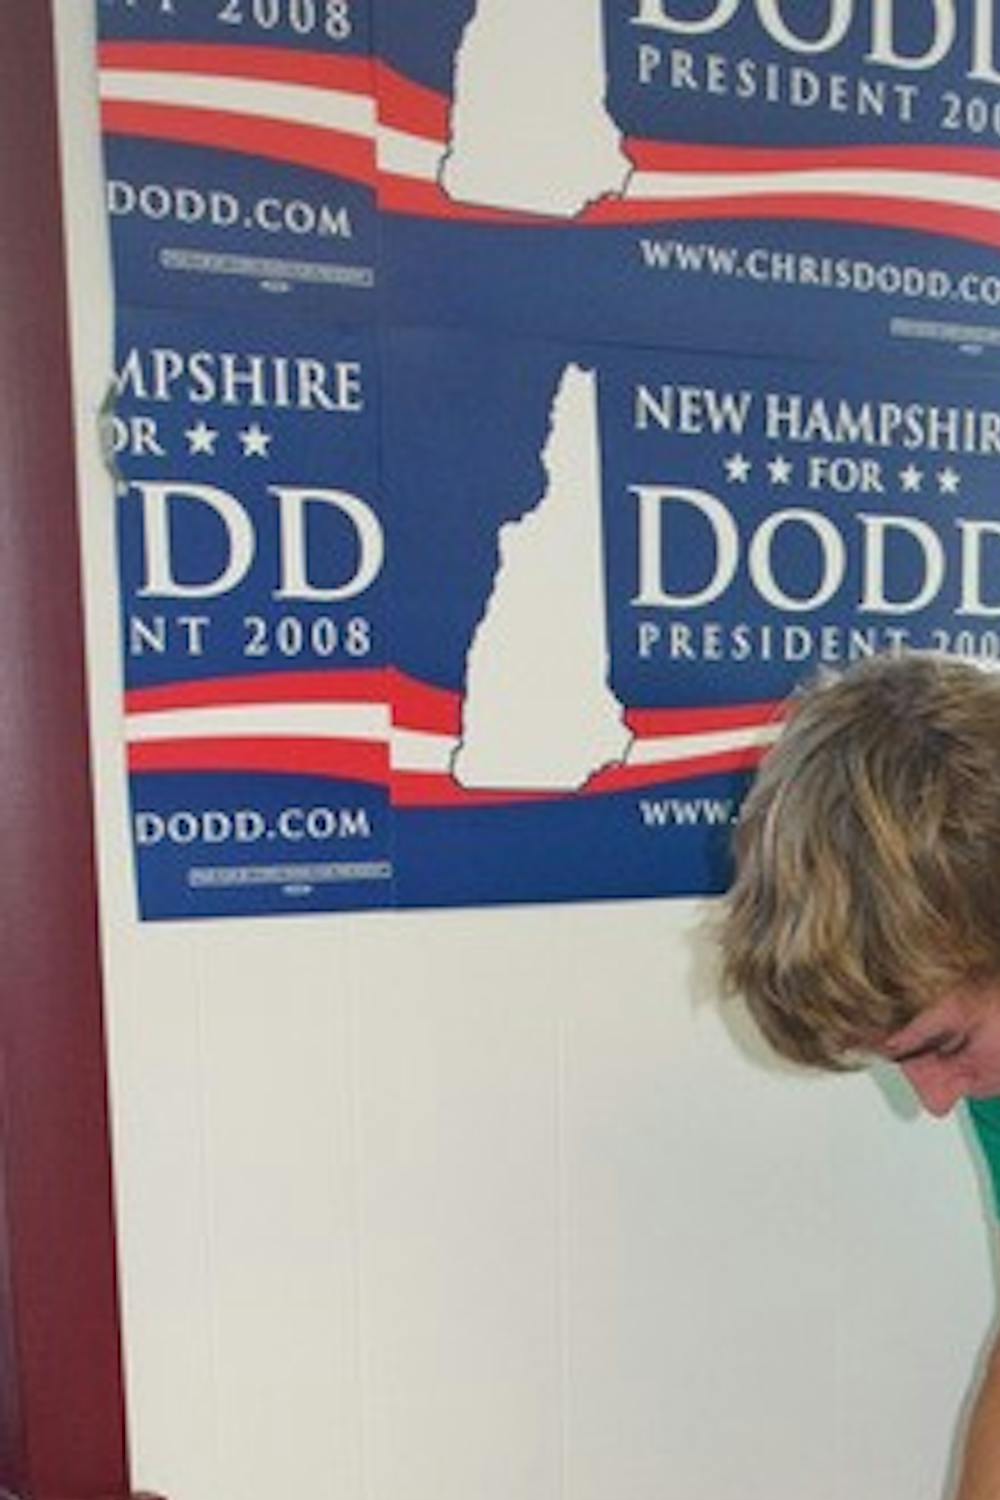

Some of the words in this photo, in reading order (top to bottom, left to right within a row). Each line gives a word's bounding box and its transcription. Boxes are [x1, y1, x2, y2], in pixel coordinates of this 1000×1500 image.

[217, 0, 352, 40] 2008
[638, 45, 919, 121] PRESIDENT
[107, 179, 351, 239] DODD.COM
[633, 383, 752, 435] NEW
[808, 456, 884, 493] FOR
[130, 614, 211, 656] NT
[243, 615, 371, 656] 2008
[637, 622, 911, 661] PRESIDENT
[135, 807, 372, 845] DODD.COM
